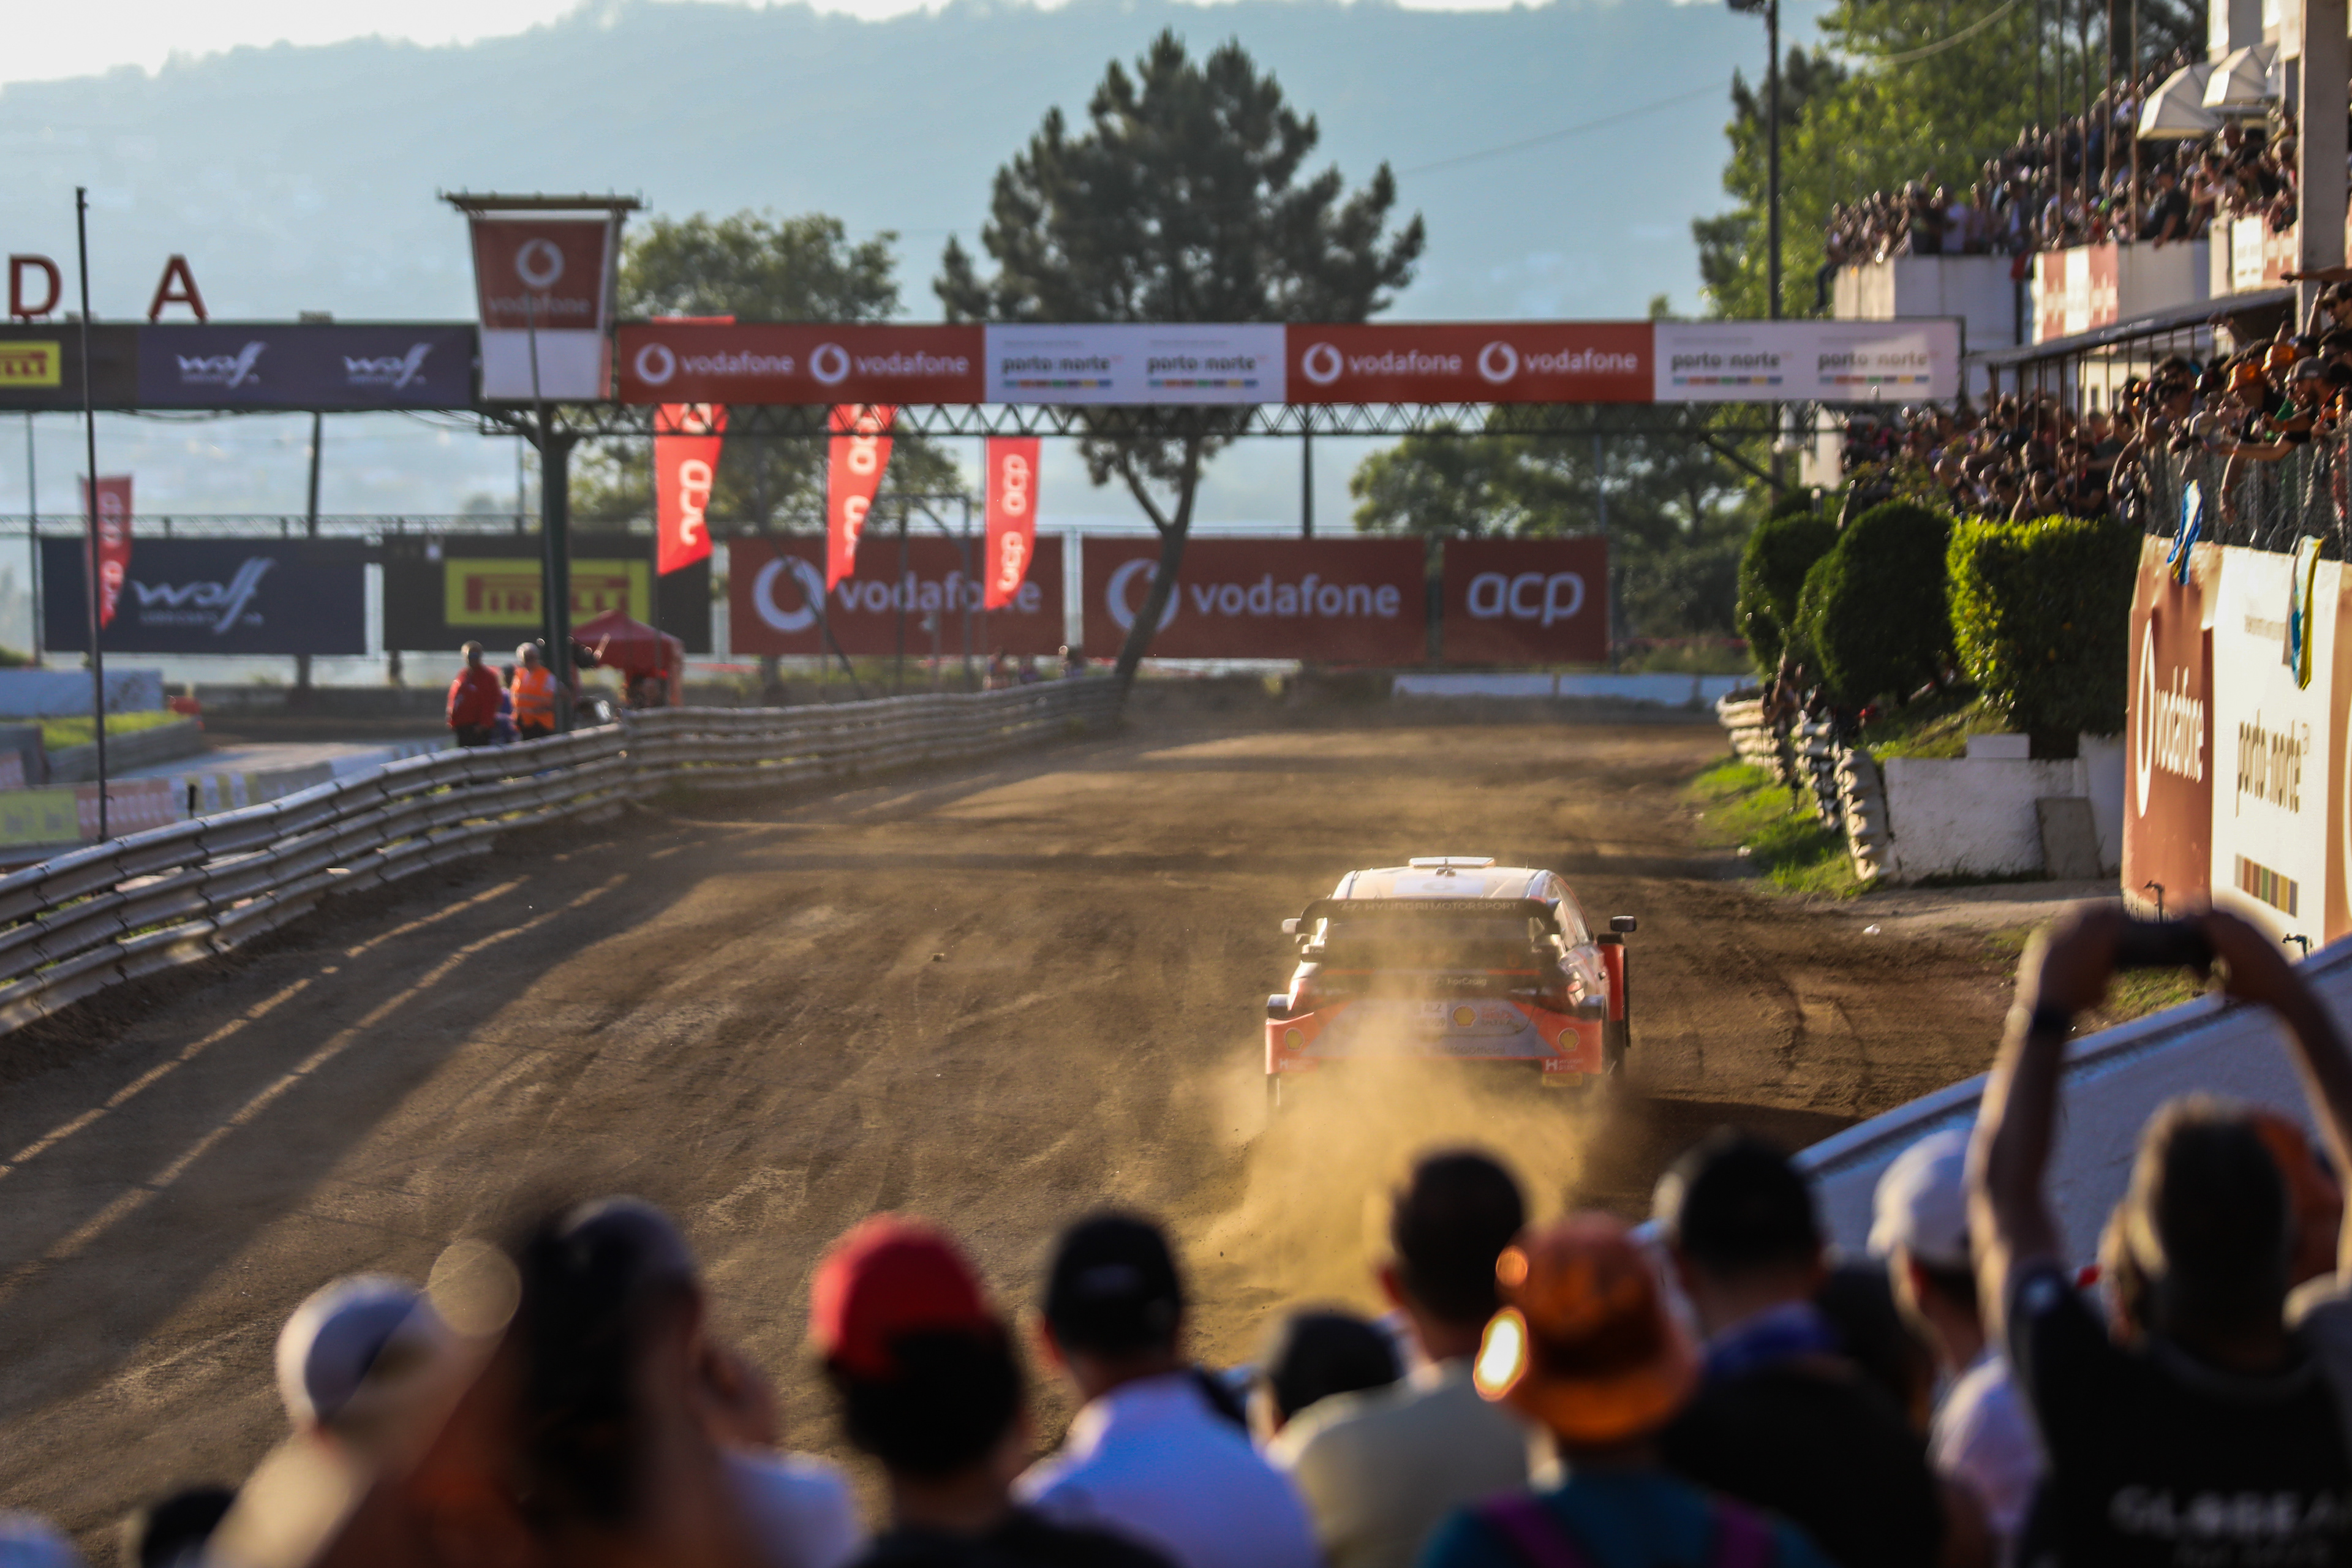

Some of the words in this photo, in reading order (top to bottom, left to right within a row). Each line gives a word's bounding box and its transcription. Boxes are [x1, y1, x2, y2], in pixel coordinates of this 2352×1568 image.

[679, 350, 794, 375] vodafone
[855, 350, 969, 377] vodafone
[1002, 355, 1052, 374] porto
[1059, 354, 1110, 371] norte
[1147, 355, 1198, 374] porto
[1205, 354, 1256, 371] norte
[1348, 351, 1461, 375] vodafone
[1524, 349, 1638, 373] vodafone
[1671, 353, 1722, 371] porto
[1728, 352, 1781, 368] norte
[1818, 352, 1868, 371] porto
[1876, 351, 1928, 368] norte
[466, 572, 630, 613] PIRLLI
[838, 571, 1041, 611] vodafoe
[1190, 573, 1401, 617] vodafone
[1466, 572, 1585, 627] acp
[2154, 665, 2204, 784] vodafone
[2236, 709, 2266, 818] porto
[2269, 719, 2302, 814] norte
[1430, 902, 1518, 912] MOTORSPORT
